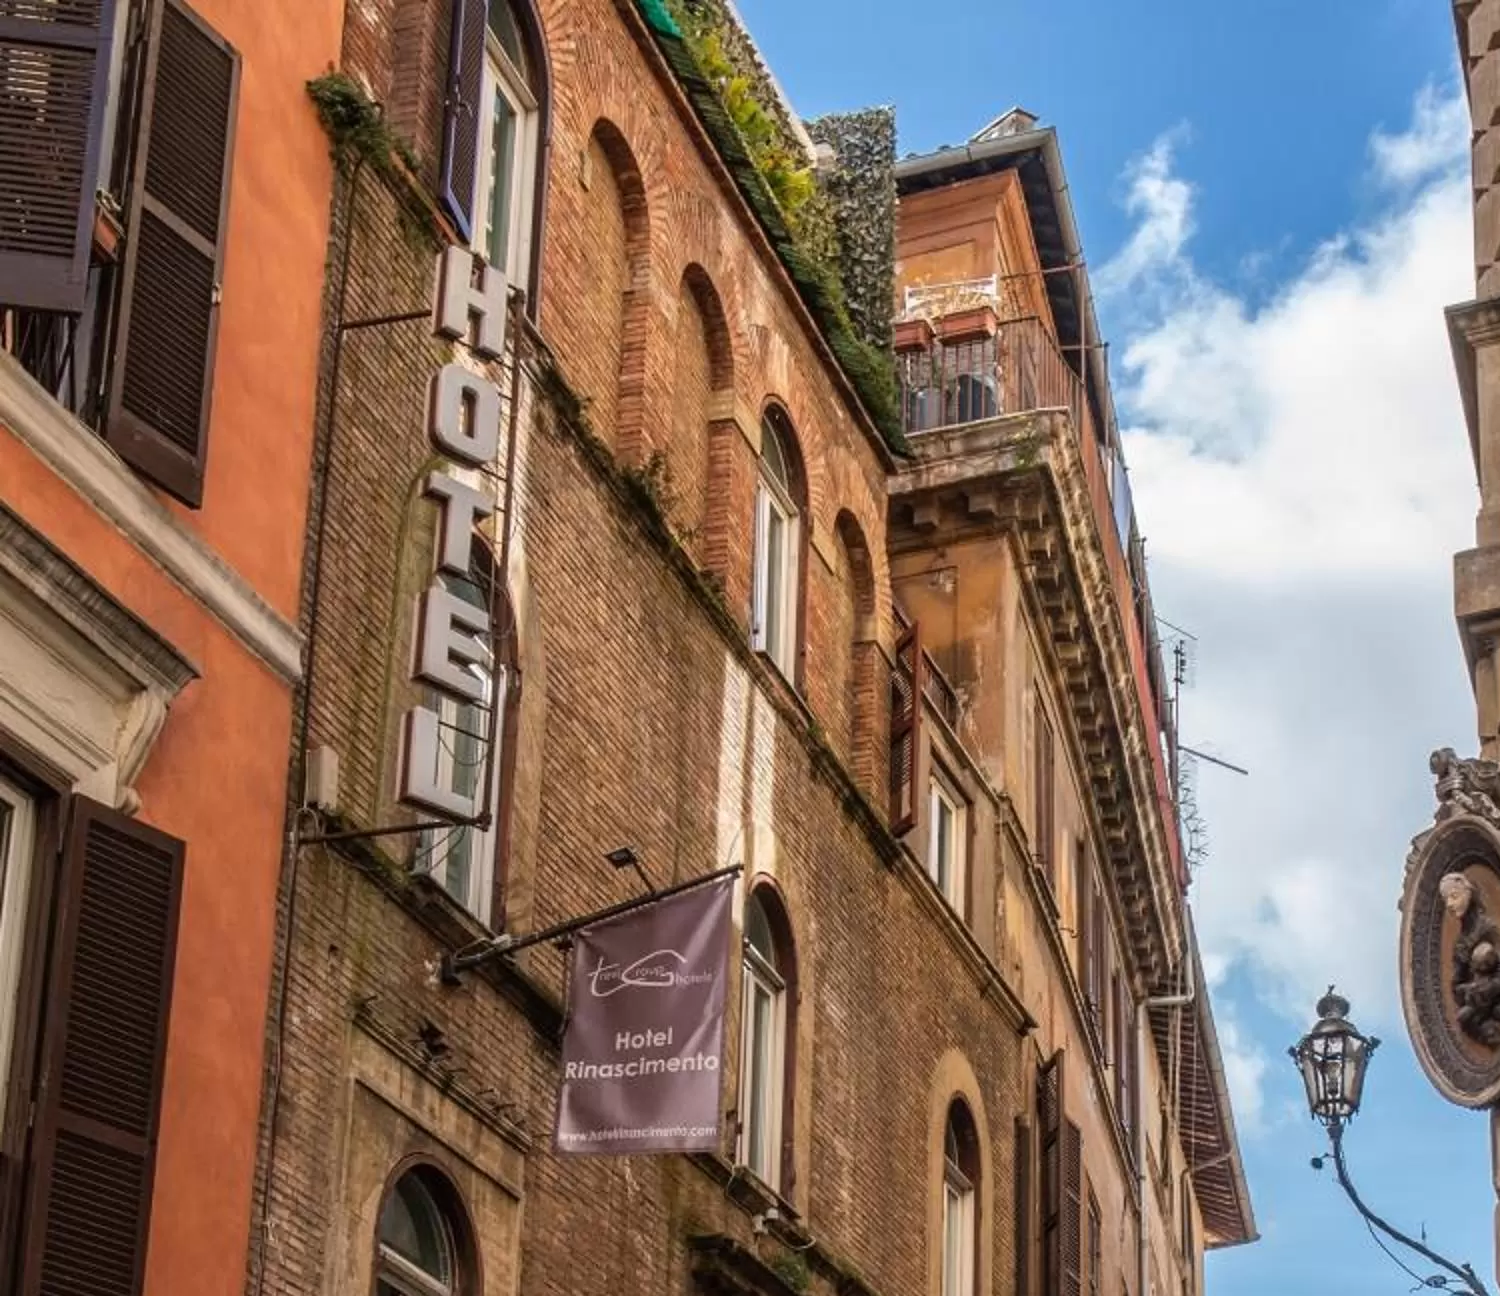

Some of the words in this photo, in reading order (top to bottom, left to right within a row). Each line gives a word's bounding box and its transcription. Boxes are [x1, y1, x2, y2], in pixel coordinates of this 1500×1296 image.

[398, 245, 508, 821] HOTEL
[615, 1026, 673, 1050] Hotel
[565, 1052, 719, 1079] Rinascimento
